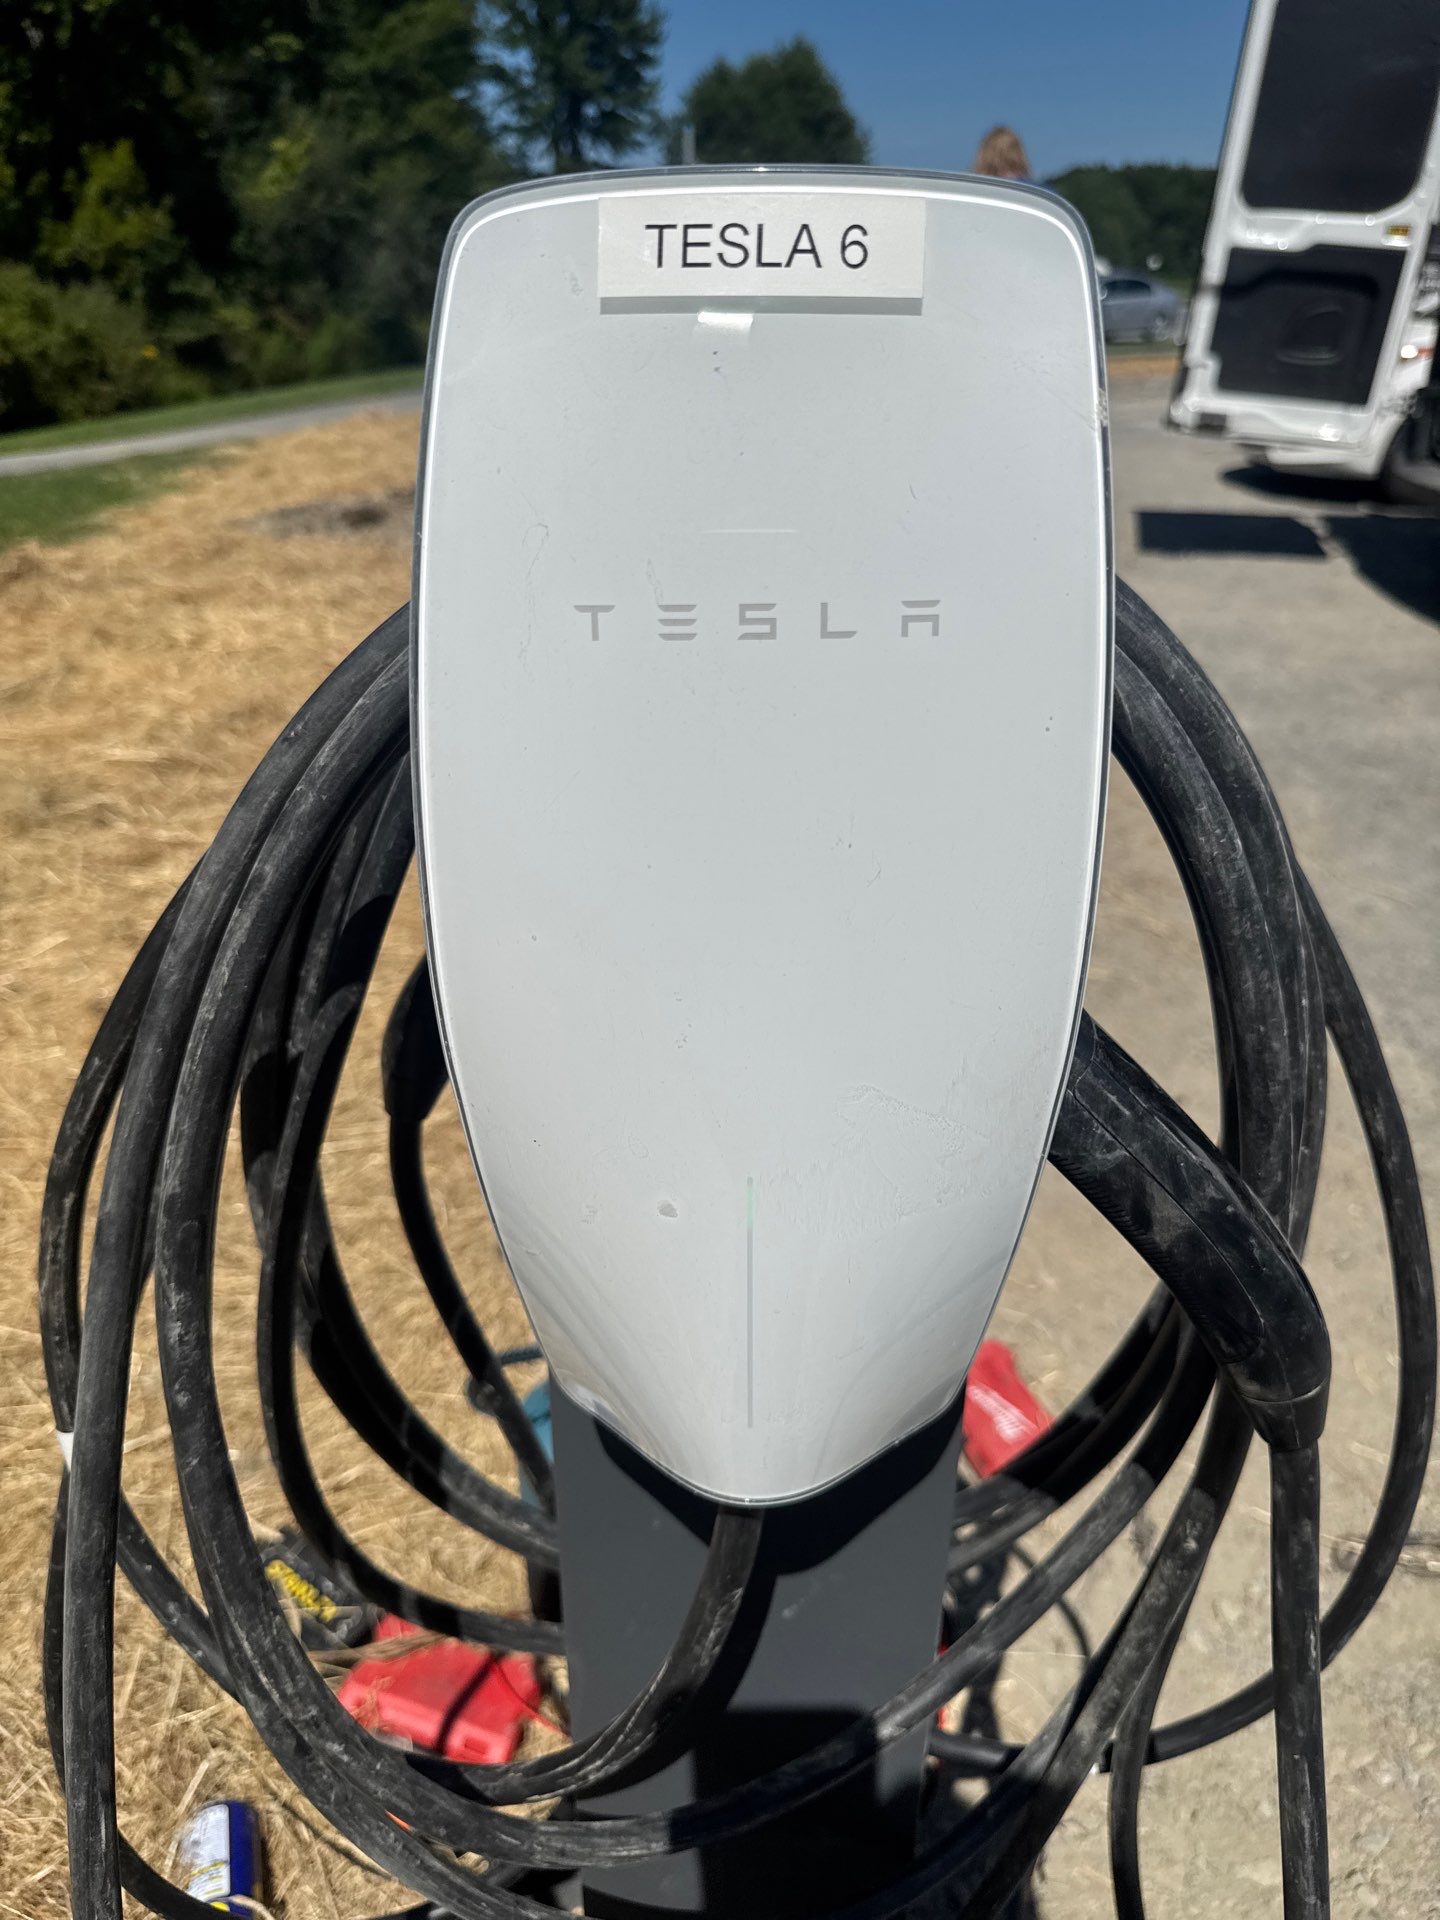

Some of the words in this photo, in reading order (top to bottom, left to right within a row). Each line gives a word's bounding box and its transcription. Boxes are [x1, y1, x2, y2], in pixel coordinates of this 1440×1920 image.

[645, 223, 822, 269] TESLA
[840, 224, 869, 269] 6
[573, 600, 941, 641] TESLA
